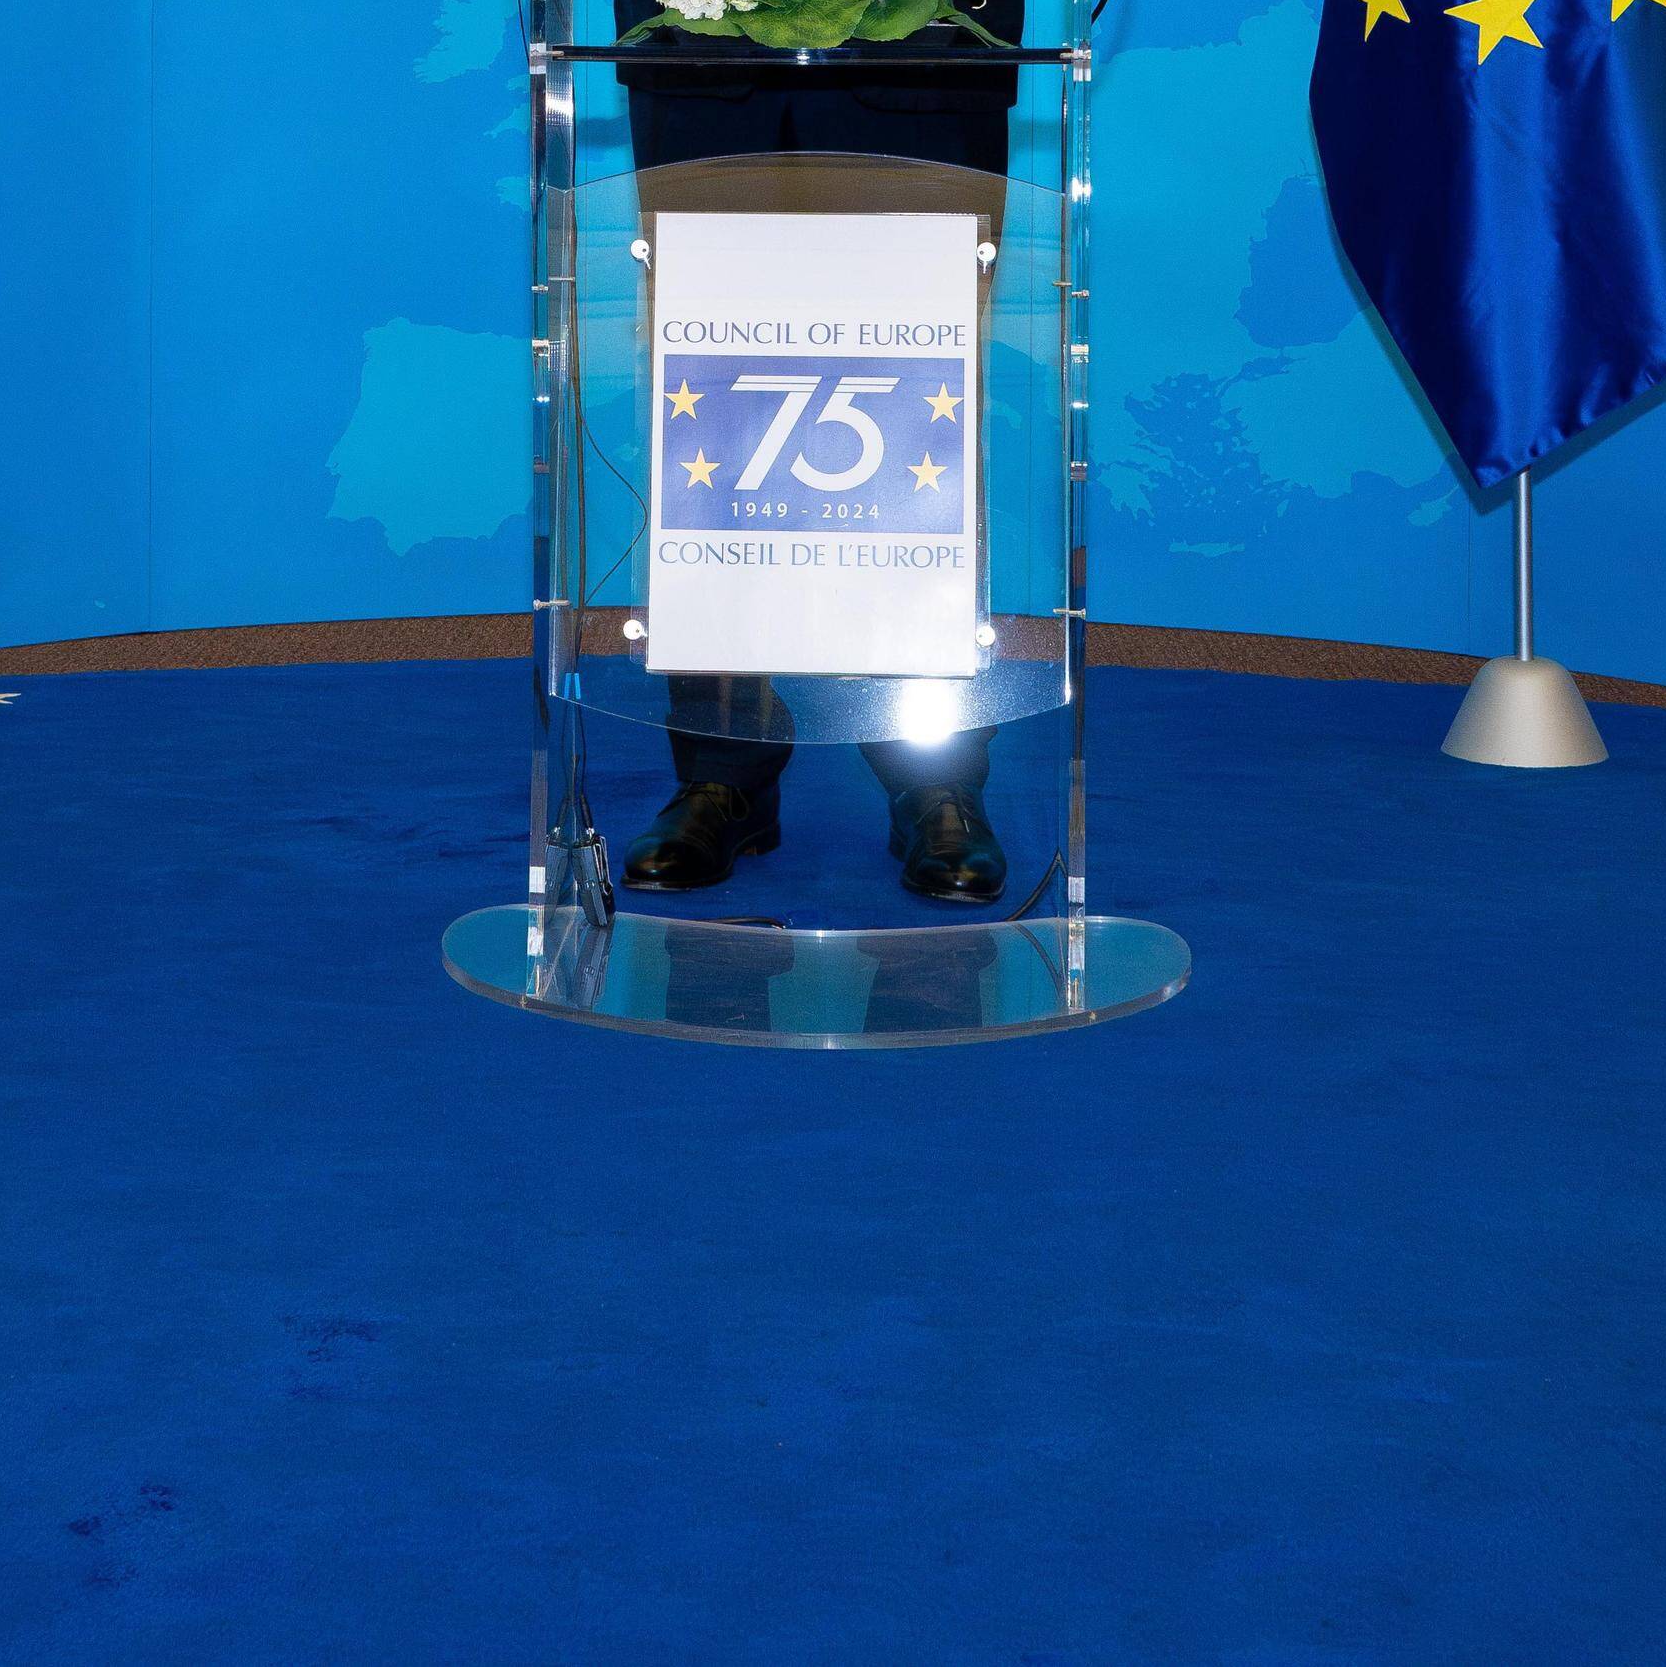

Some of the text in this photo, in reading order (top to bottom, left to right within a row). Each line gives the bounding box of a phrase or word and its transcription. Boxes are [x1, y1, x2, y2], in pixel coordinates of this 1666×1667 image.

[663, 321, 965, 346] COUNCIL OF EUROPE
[730, 375, 901, 492] 75
[731, 501, 788, 518] 1949
[822, 502, 880, 519] 2024
[659, 542, 963, 567] CONSEIL DE L'EUROPE
